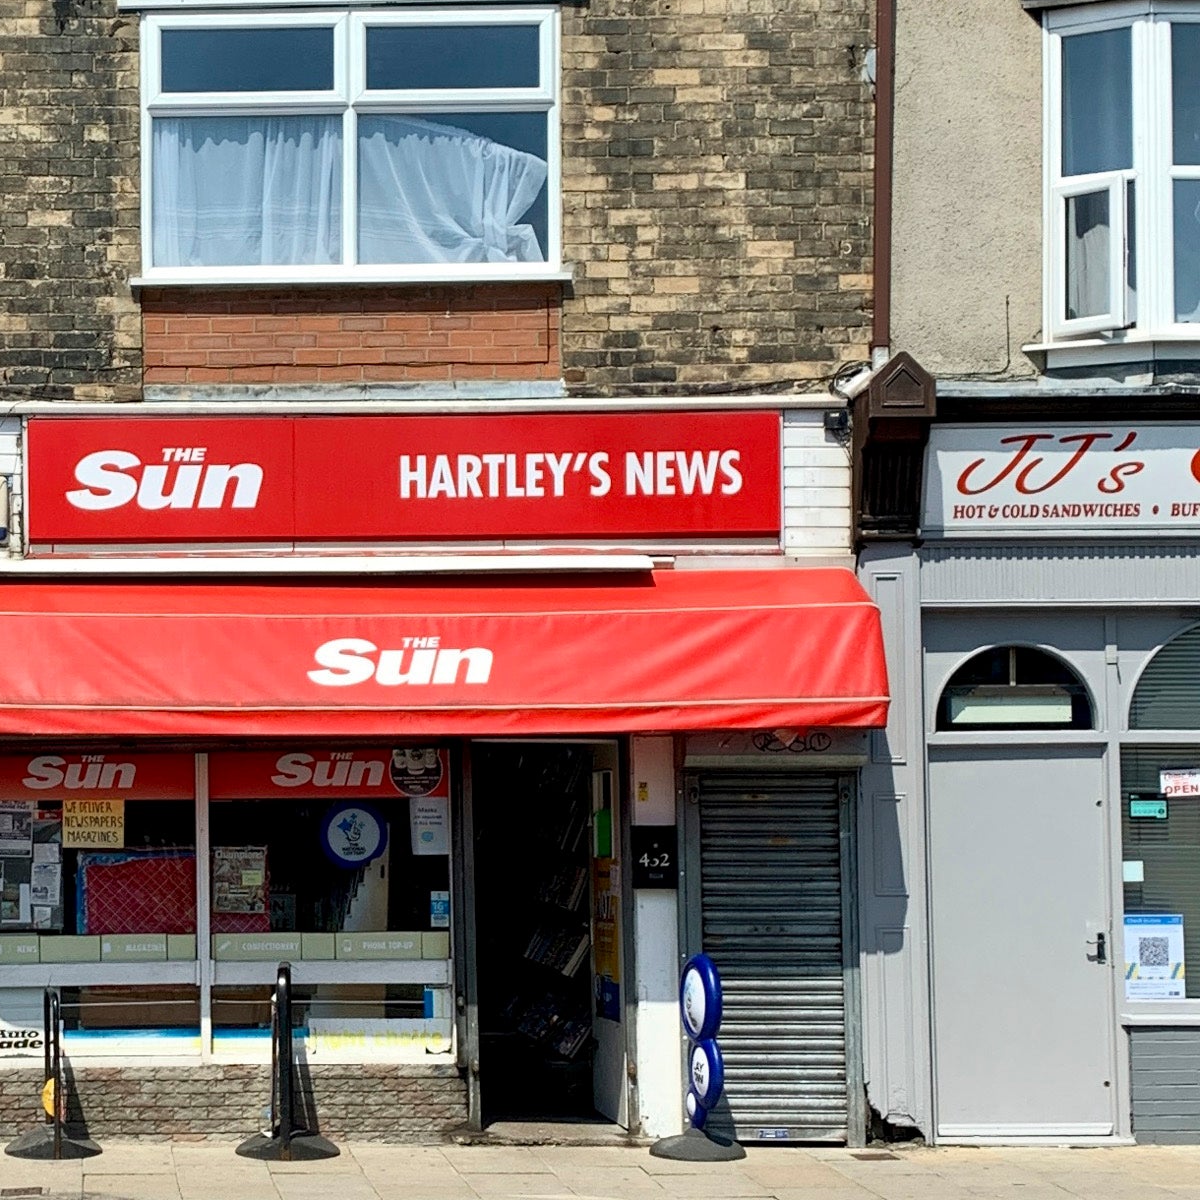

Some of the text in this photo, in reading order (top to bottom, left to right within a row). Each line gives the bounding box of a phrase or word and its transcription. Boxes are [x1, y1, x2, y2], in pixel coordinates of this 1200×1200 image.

[161, 447, 207, 462] THE
[956, 431, 1145, 495] JJ's
[65, 450, 264, 511] Sun
[399, 449, 743, 499] HARTLEY'S NEWS
[953, 505, 986, 519] HOT
[988, 506, 1000, 518] &
[1002, 504, 1040, 518] COLD
[1042, 503, 1141, 518] SANDWICHES
[402, 636, 441, 648] THE
[307, 637, 494, 687] Sun
[330, 752, 353, 760] THE
[22, 755, 136, 789] Sun
[271, 753, 385, 787] Sun
[1164, 784, 1199, 794] OPEN
[64, 801, 112, 813] WE DELIVER
[64, 816, 123, 828] NEWSPAPERS
[67, 831, 119, 843] MAGAZINES
[16, 944, 37, 953] NEWS
[362, 941, 414, 950] PHONE TOP-UP
